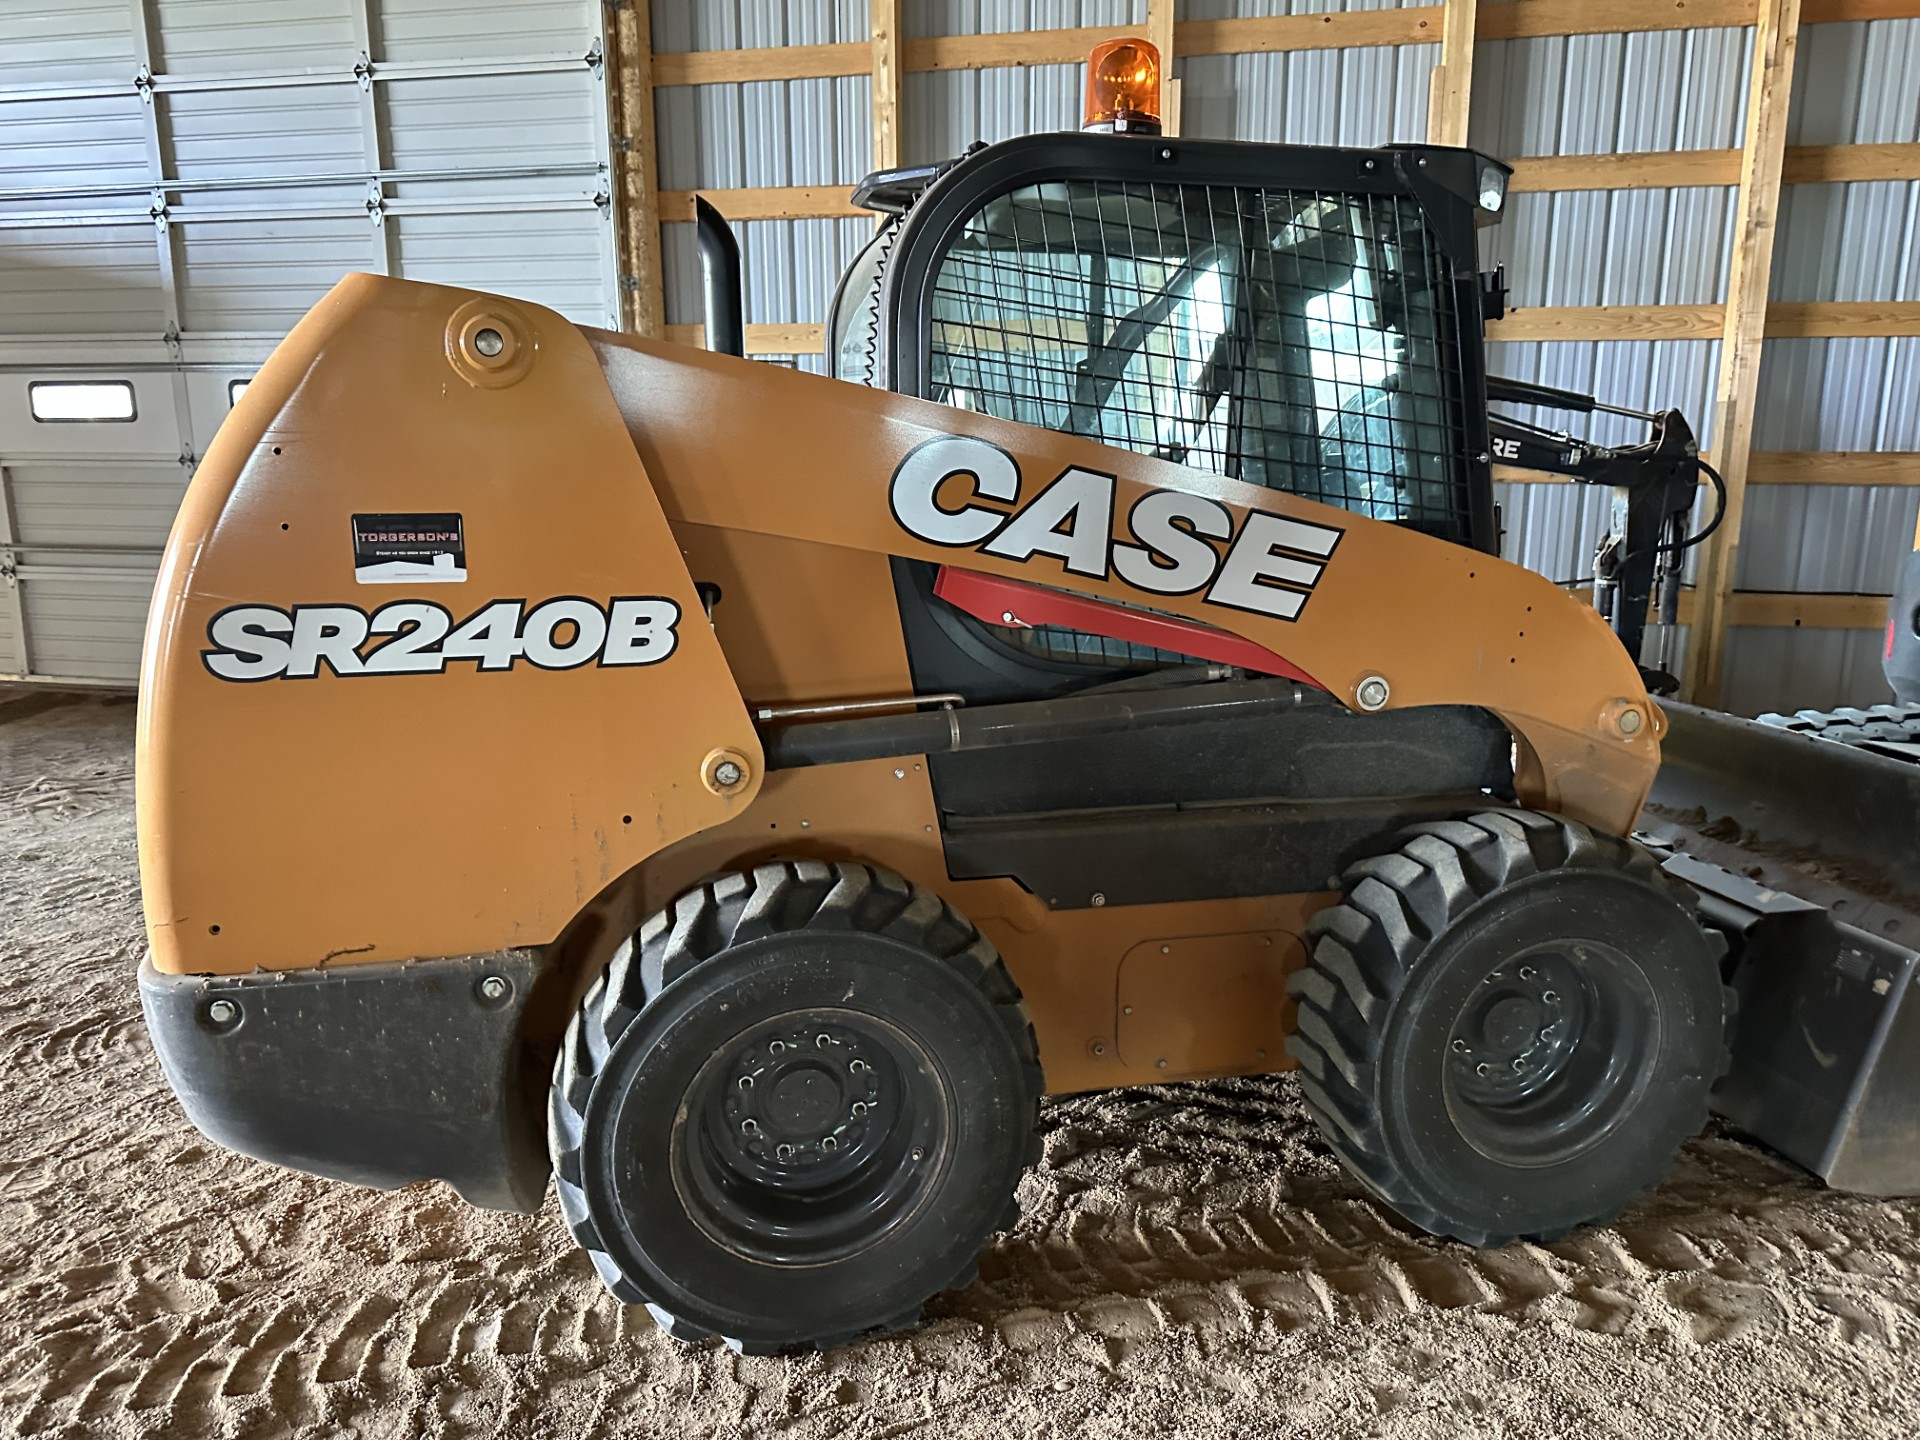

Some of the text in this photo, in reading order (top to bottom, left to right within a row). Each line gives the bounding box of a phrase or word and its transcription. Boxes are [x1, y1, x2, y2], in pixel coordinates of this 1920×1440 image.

[358, 532, 459, 542] TORGERSON'S
[888, 434, 1345, 622] CASE
[201, 596, 680, 682] SR240B
